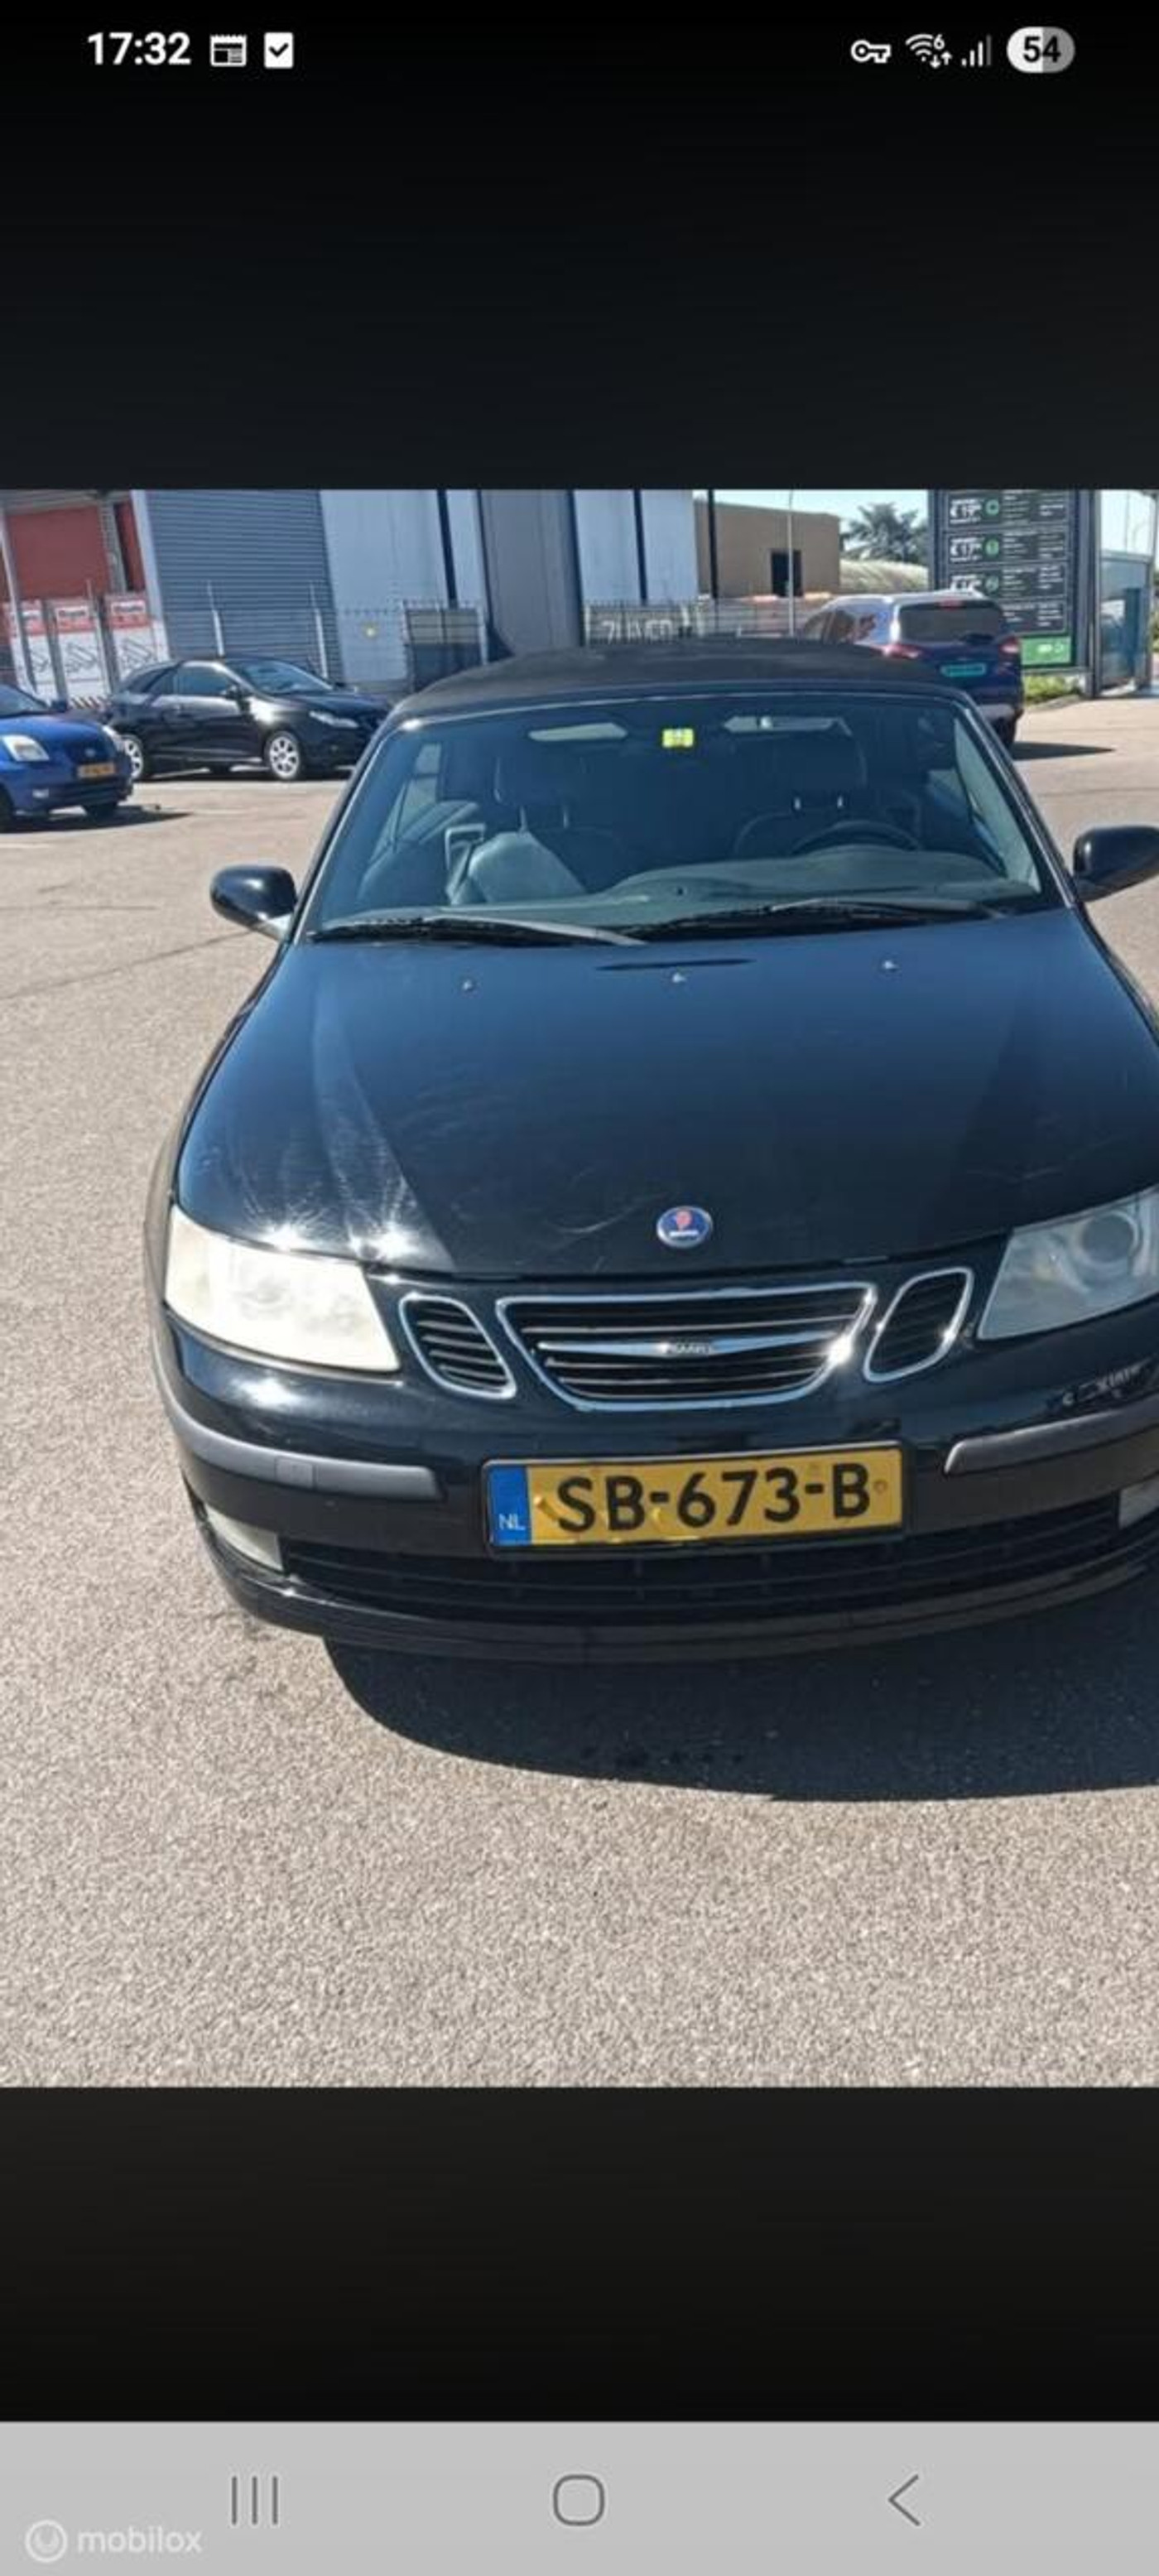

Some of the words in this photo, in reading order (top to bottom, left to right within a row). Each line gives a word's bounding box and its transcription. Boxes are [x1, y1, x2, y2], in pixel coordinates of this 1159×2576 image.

[88, 31, 191, 65] 17:32
[1022, 35, 1061, 64] 54
[556, 1462, 871, 1532] SB-673-B
[498, 1513, 526, 1531] NL
